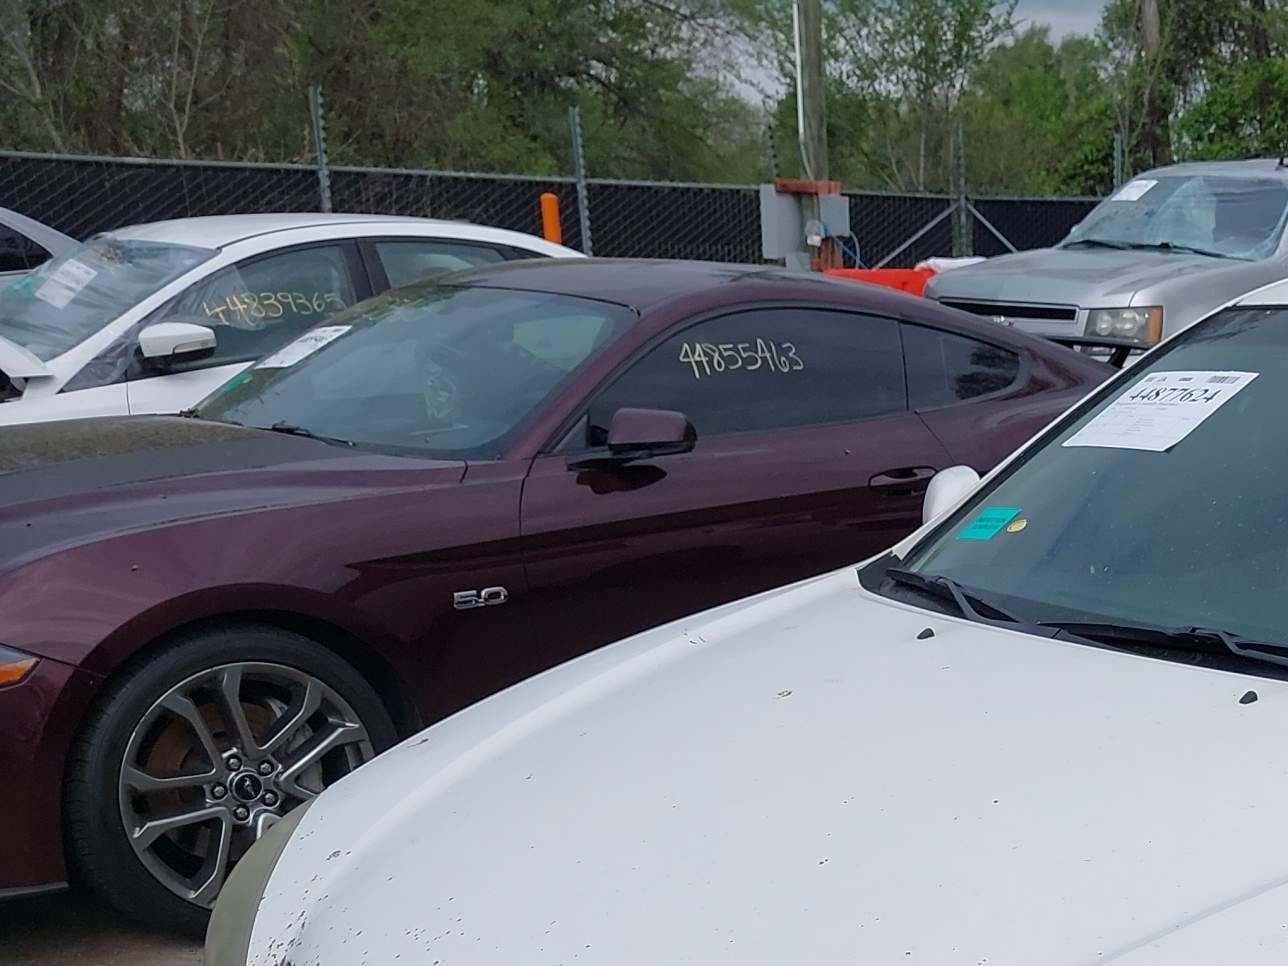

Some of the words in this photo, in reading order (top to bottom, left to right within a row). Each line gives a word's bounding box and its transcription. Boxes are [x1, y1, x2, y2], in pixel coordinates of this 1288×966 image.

[678, 336, 805, 379] 44855463
[1129, 387, 1222, 404] 44877624
[453, 586, 509, 610] 5.0
